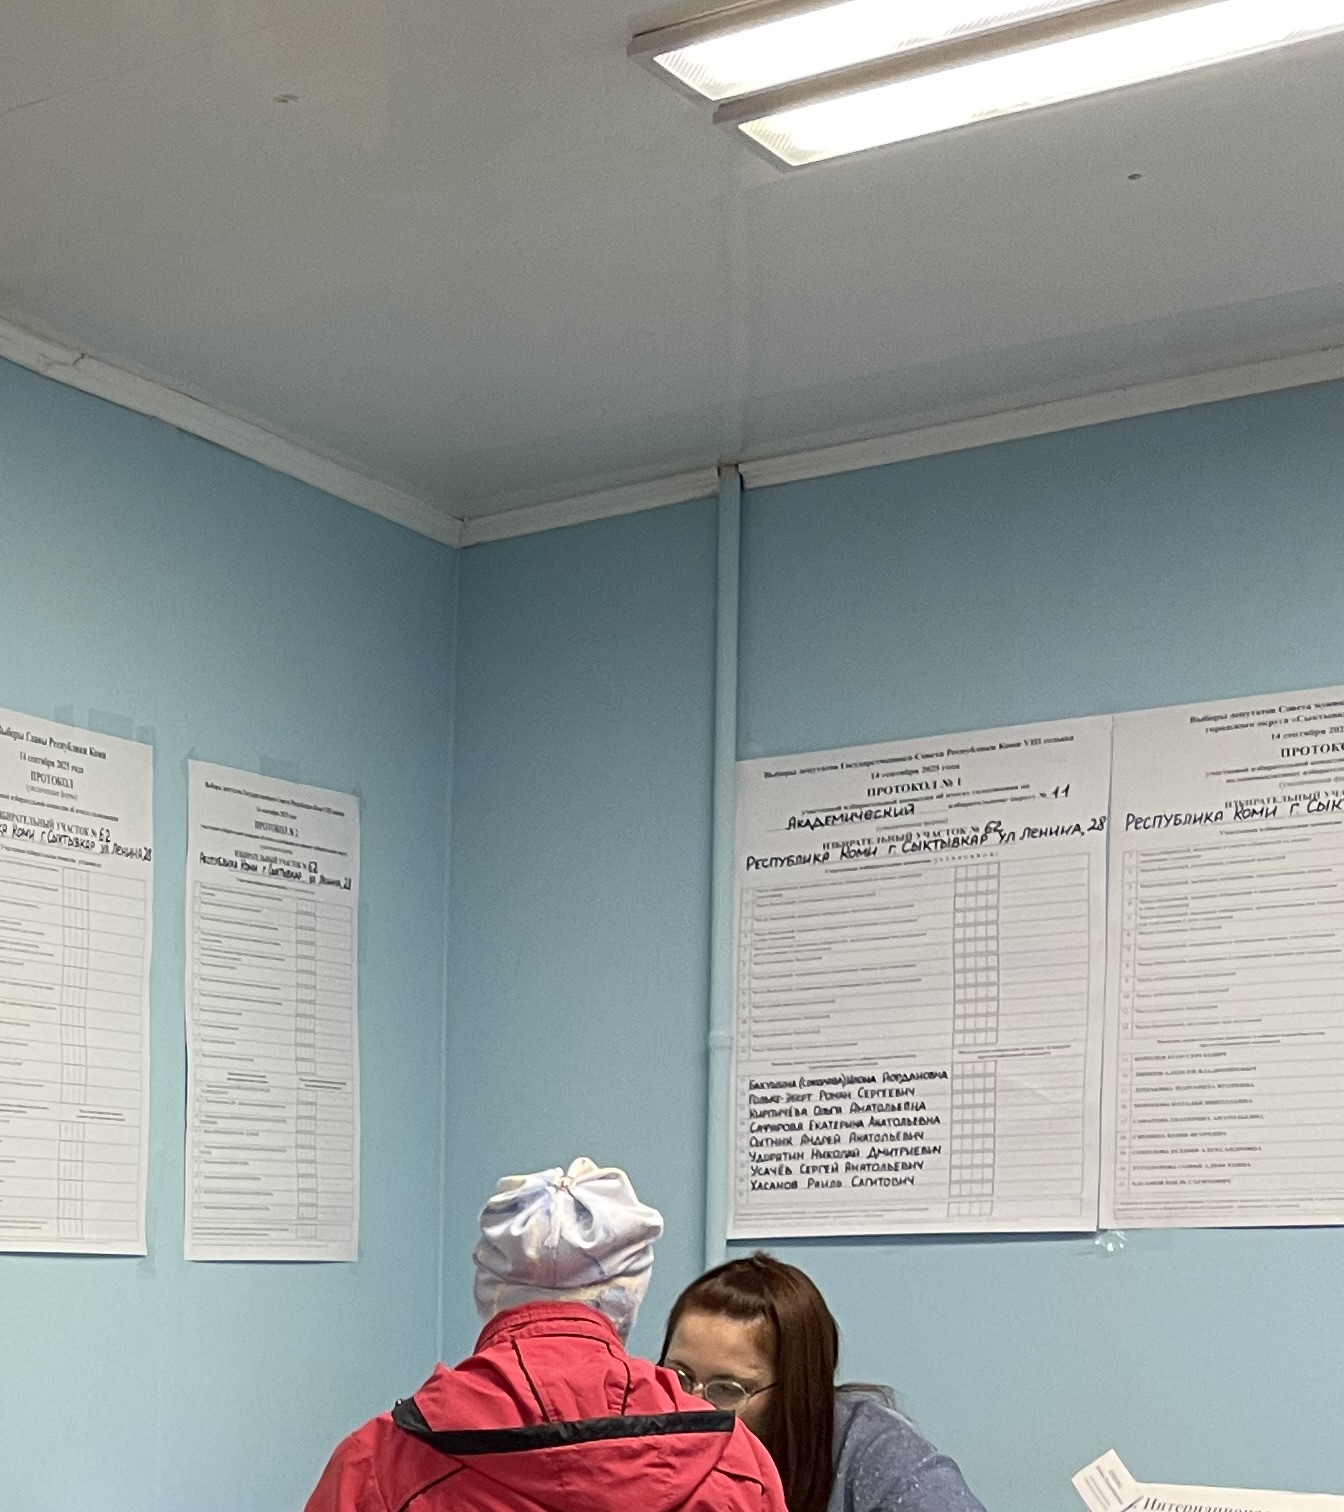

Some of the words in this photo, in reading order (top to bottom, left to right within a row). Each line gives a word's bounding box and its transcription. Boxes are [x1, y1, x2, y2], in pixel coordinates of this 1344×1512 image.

[30, 770, 74, 789] ПРОТОКОЛ
[867, 780, 937, 797] ПРОТОКОЛ
[1052, 783, 1070, 798] 11
[1087, 815, 1106, 832] 28
